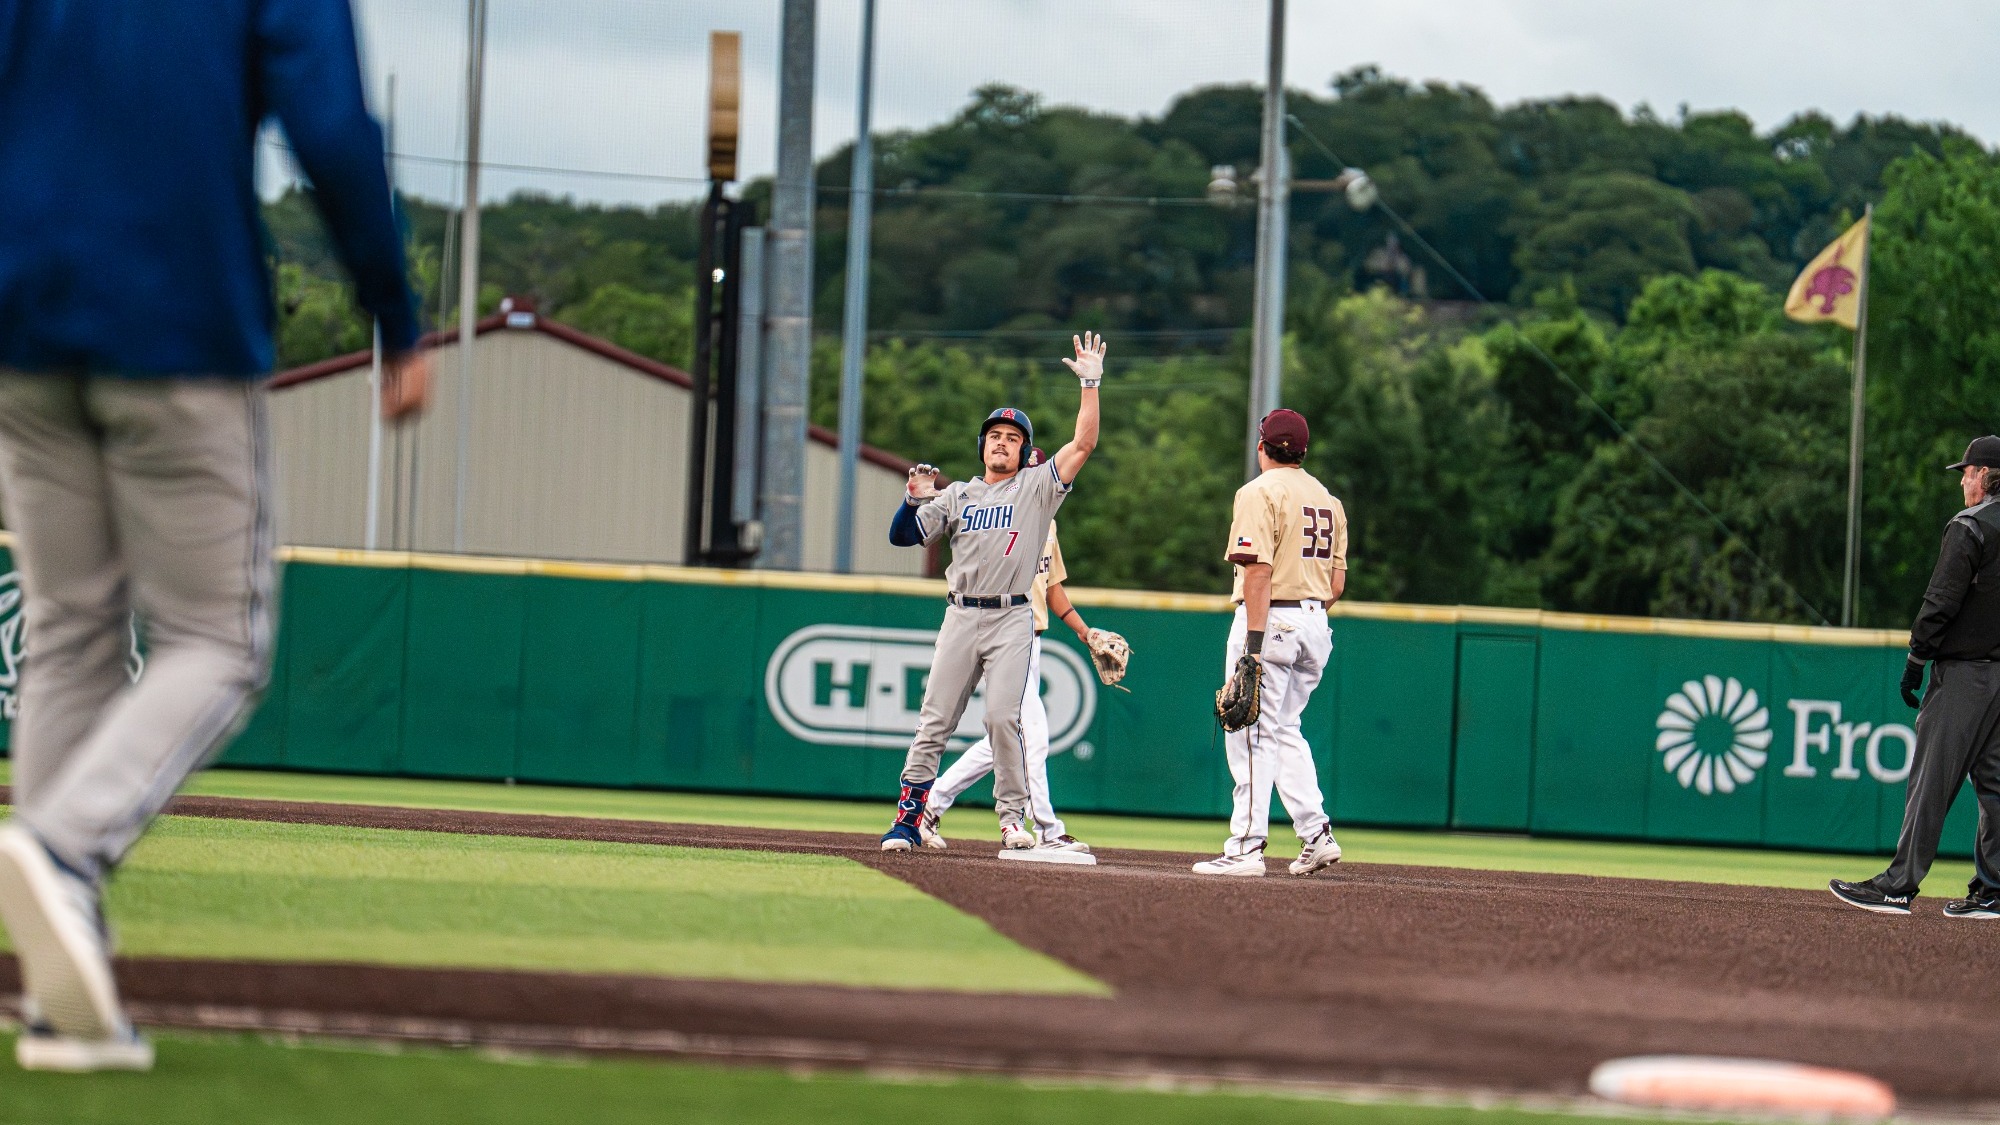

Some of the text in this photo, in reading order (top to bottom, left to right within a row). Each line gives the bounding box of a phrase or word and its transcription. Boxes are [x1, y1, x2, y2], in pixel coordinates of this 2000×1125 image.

[960, 504, 1014, 533] SOUTH
[1302, 506, 1334, 559] 33
[1004, 531, 1019, 556] 7
[1784, 698, 1917, 783] Fro
[1883, 895, 1908, 904] HOKA
